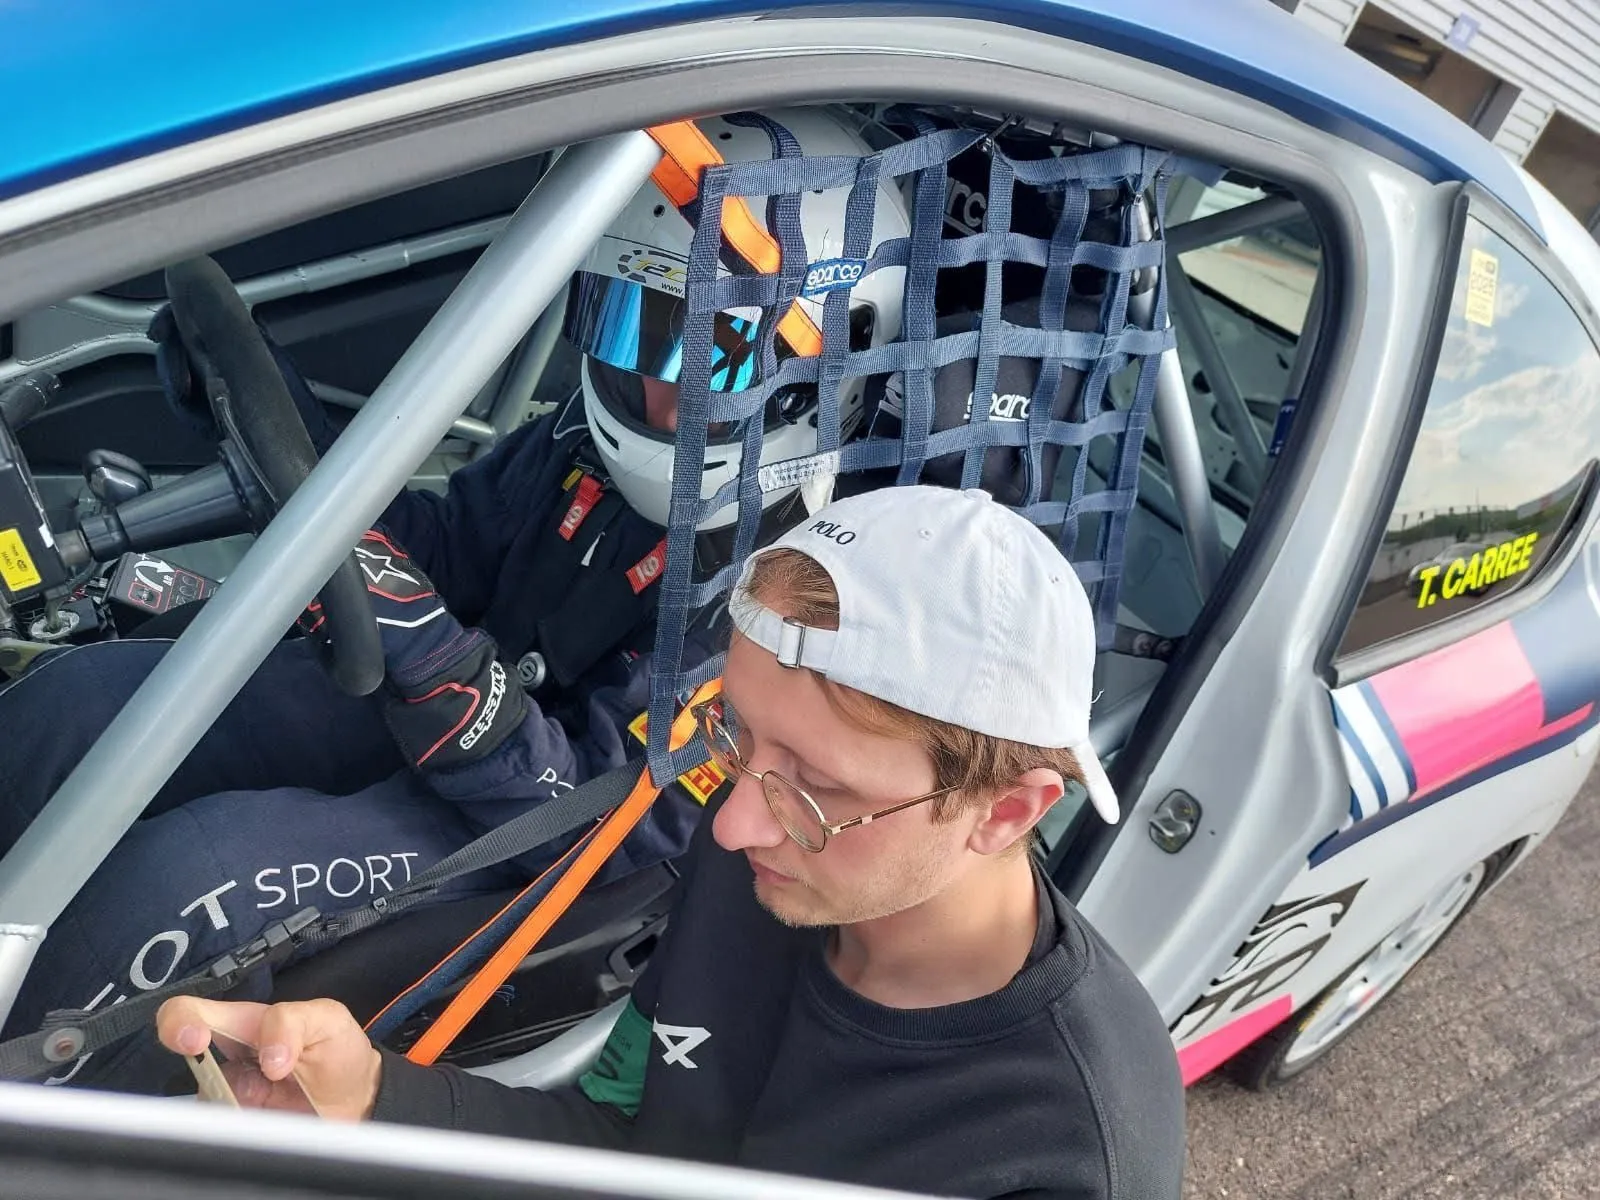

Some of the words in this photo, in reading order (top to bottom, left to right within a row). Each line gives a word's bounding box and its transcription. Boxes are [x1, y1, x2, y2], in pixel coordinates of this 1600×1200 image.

[807, 263, 862, 287] sparco
[808, 519, 857, 545] POLO
[1417, 565, 1441, 609] T.
[1441, 532, 1539, 600] CARREE
[255, 852, 419, 909] SPORT
